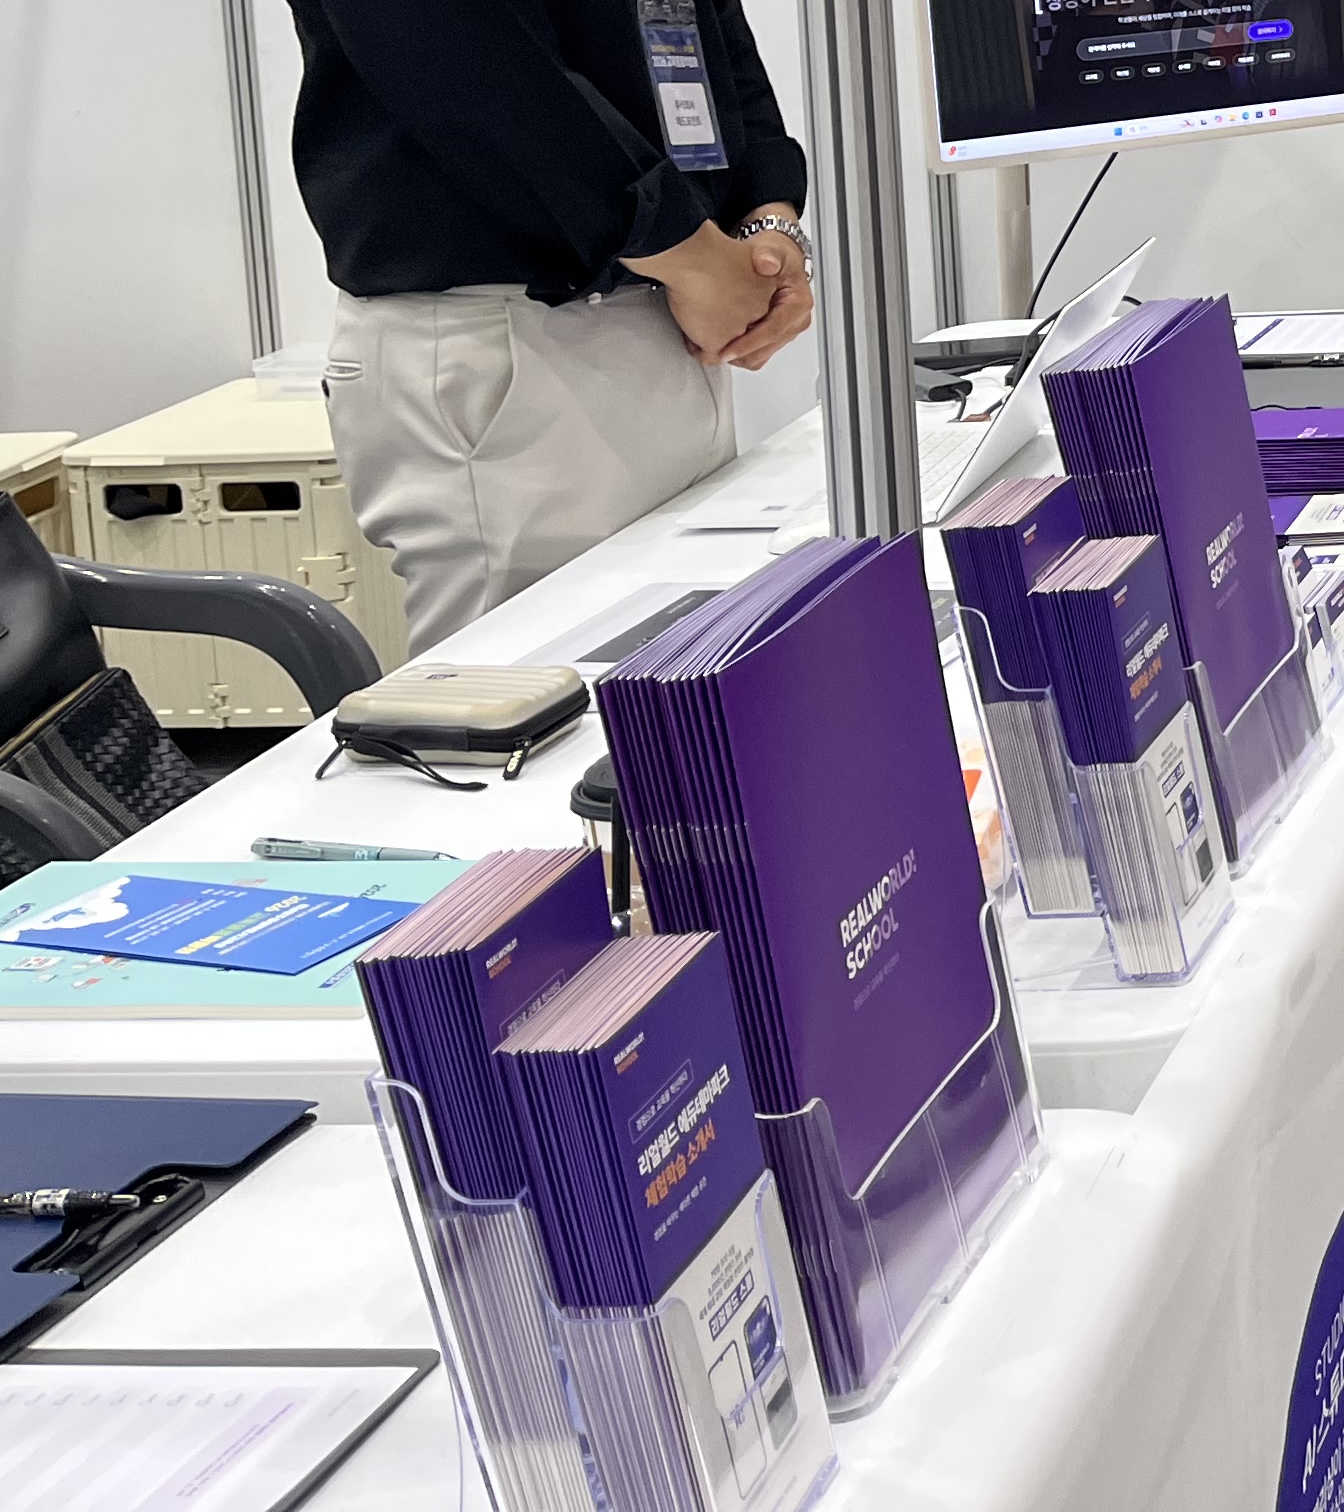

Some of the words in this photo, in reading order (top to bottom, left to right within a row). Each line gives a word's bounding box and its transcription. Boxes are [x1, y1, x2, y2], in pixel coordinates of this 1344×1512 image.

[840, 848, 917, 948] REALWORLD!
[846, 907, 900, 980] SCHOOL
[637, 1121, 680, 1176] 리얼월드
[677, 1062, 731, 1133] 에듀테마파크
